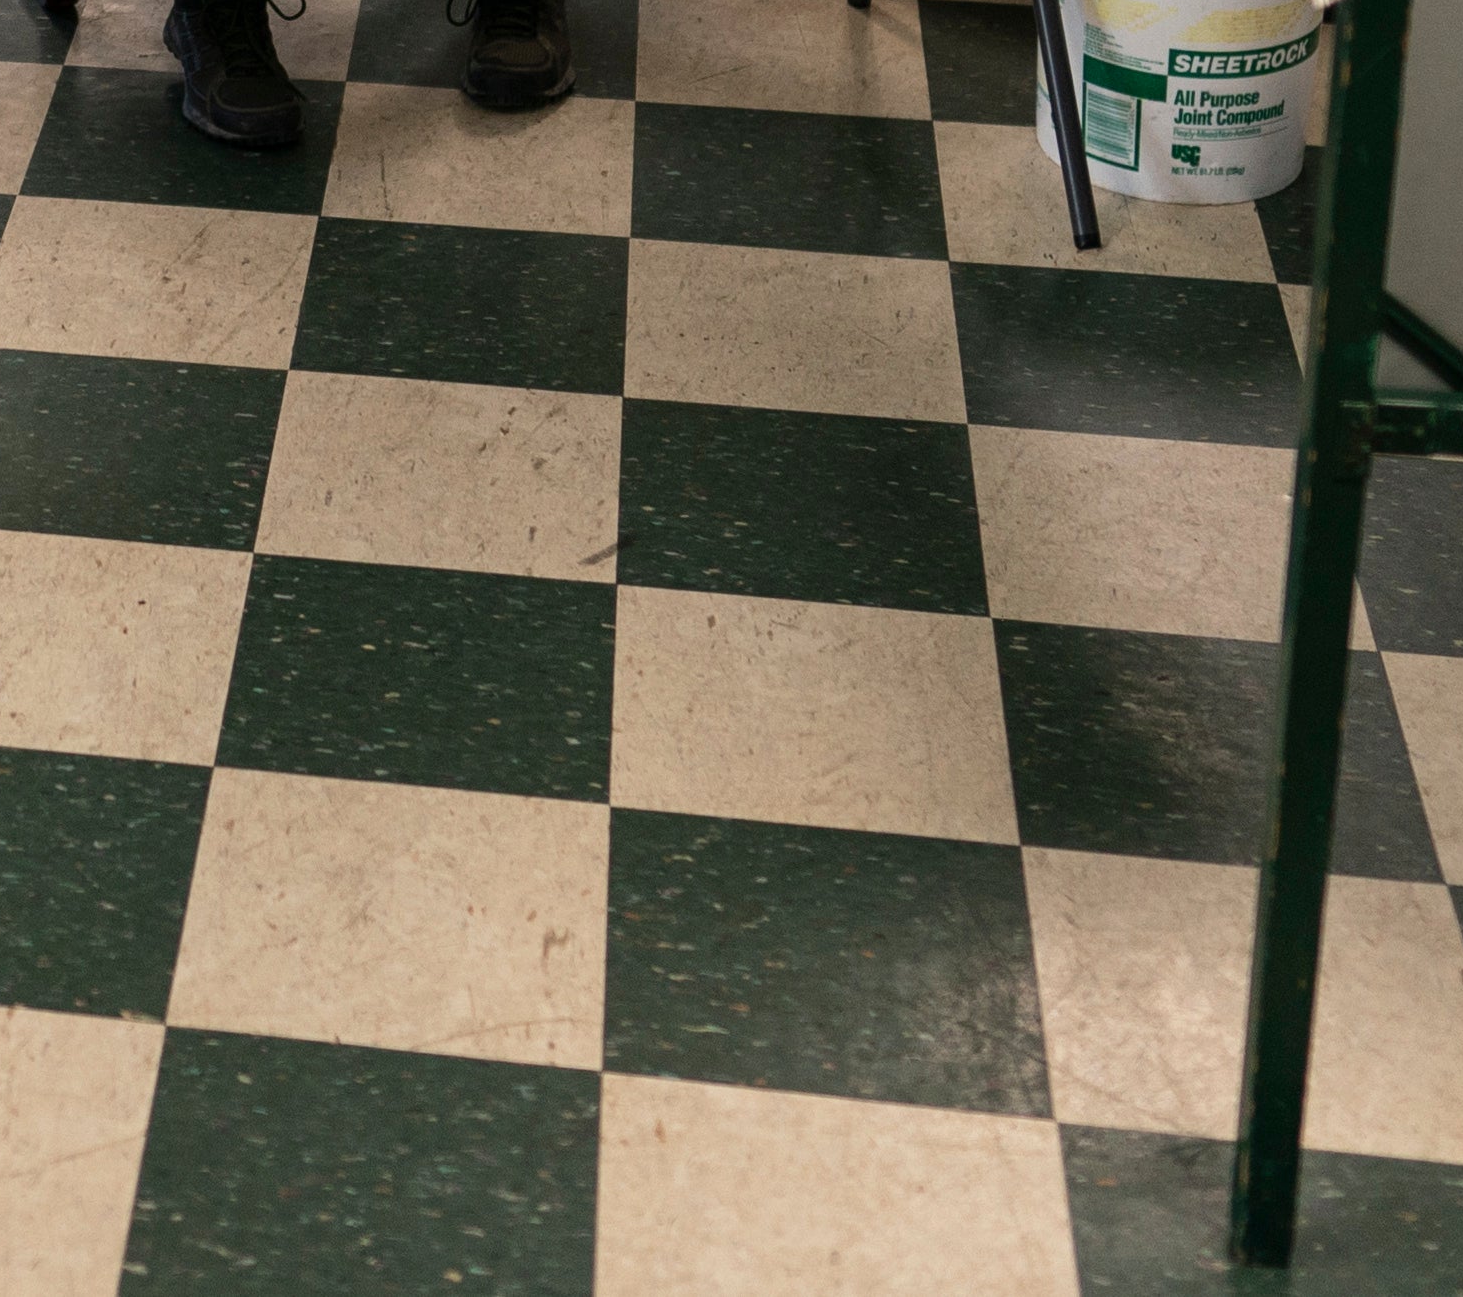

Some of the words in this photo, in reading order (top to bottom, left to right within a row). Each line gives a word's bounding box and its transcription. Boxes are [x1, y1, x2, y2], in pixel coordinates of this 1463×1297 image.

[1174, 38, 1309, 74] SHEETROCK
[1174, 89, 1195, 106] All
[1200, 91, 1260, 109] Purpose
[1174, 108, 1212, 125] Joint
[1217, 99, 1285, 126] Compound
[1171, 144, 1201, 167] USG
